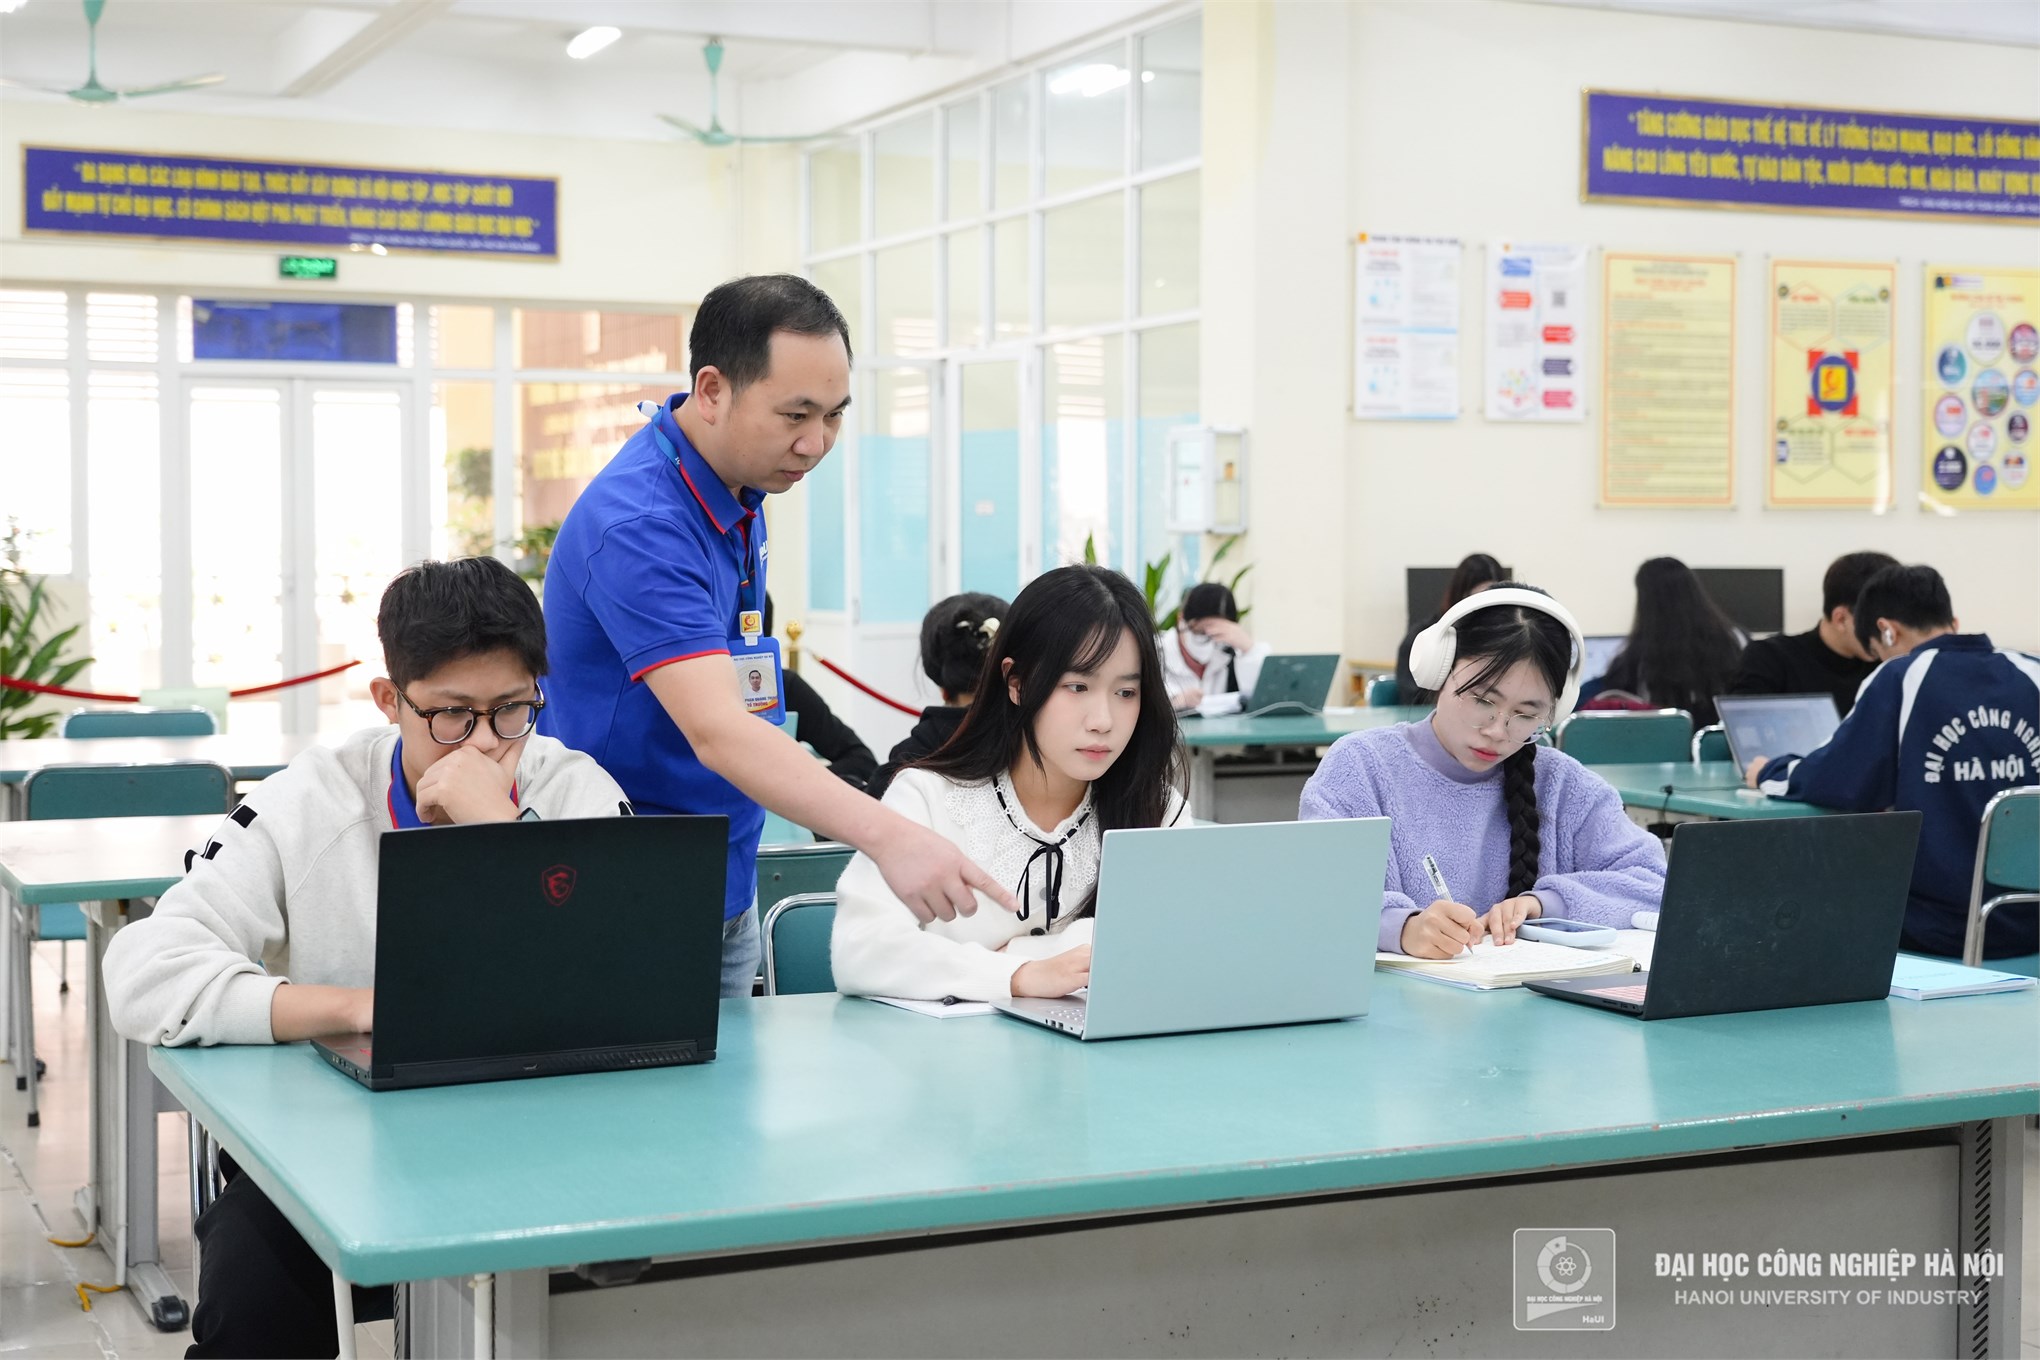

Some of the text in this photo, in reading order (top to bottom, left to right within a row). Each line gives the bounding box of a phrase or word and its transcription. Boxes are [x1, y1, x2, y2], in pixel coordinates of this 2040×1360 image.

[1967, 705, 2011, 729] CÔNG
[1932, 717, 1966, 751] HỌC
[1924, 752, 1945, 783] ĐẠI
[1954, 754, 2025, 782] HÀ NỘI
